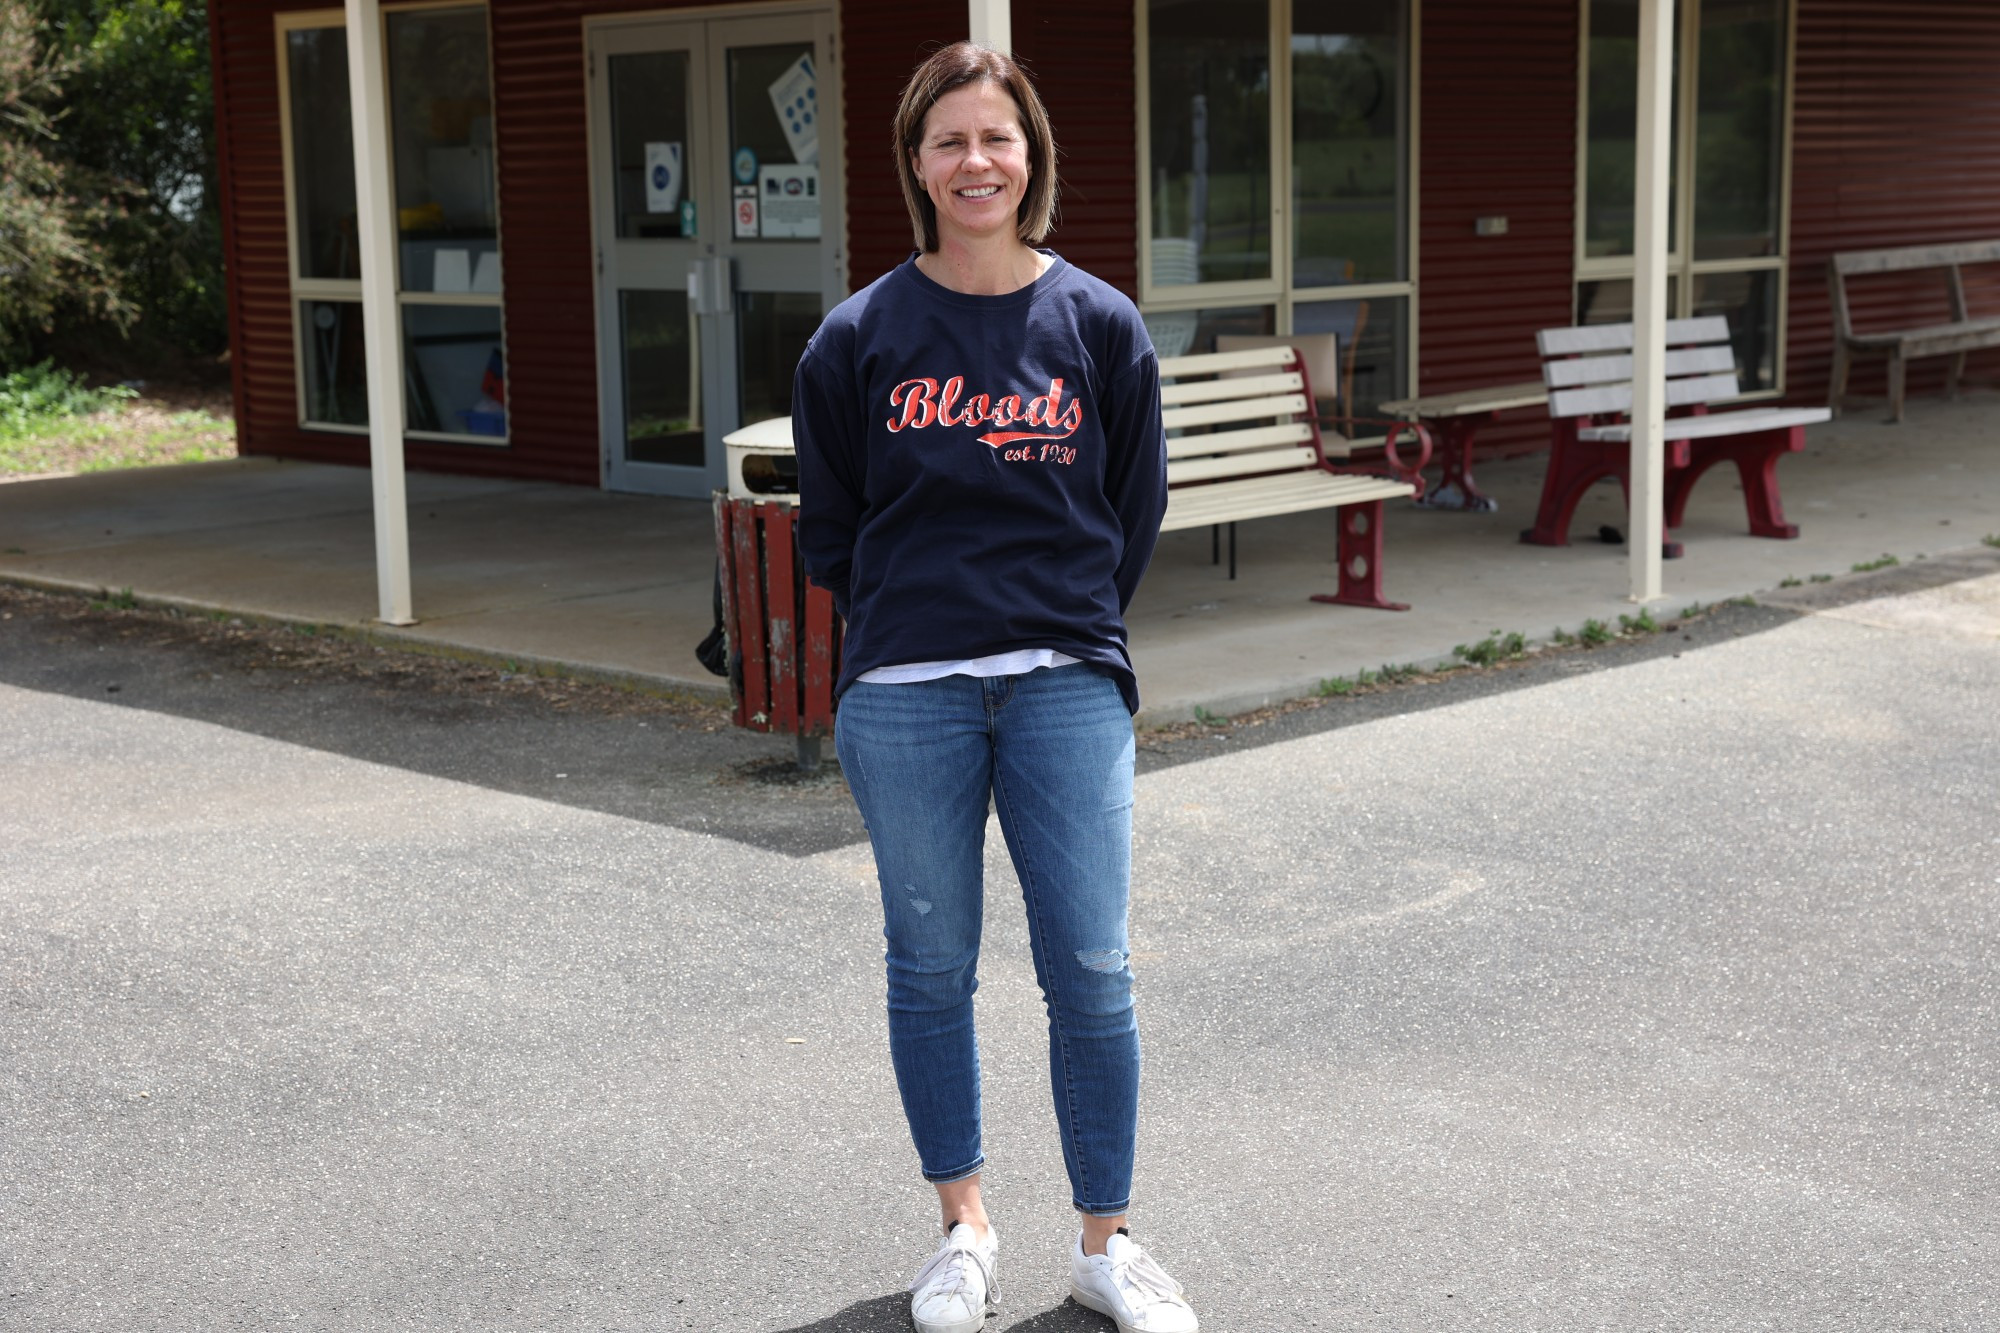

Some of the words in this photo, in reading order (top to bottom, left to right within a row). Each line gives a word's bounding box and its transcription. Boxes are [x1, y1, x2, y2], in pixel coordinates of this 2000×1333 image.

[887, 375, 1083, 433] Bloods
[1004, 446, 1036, 463] est.
[1040, 443, 1077, 465] 1930
